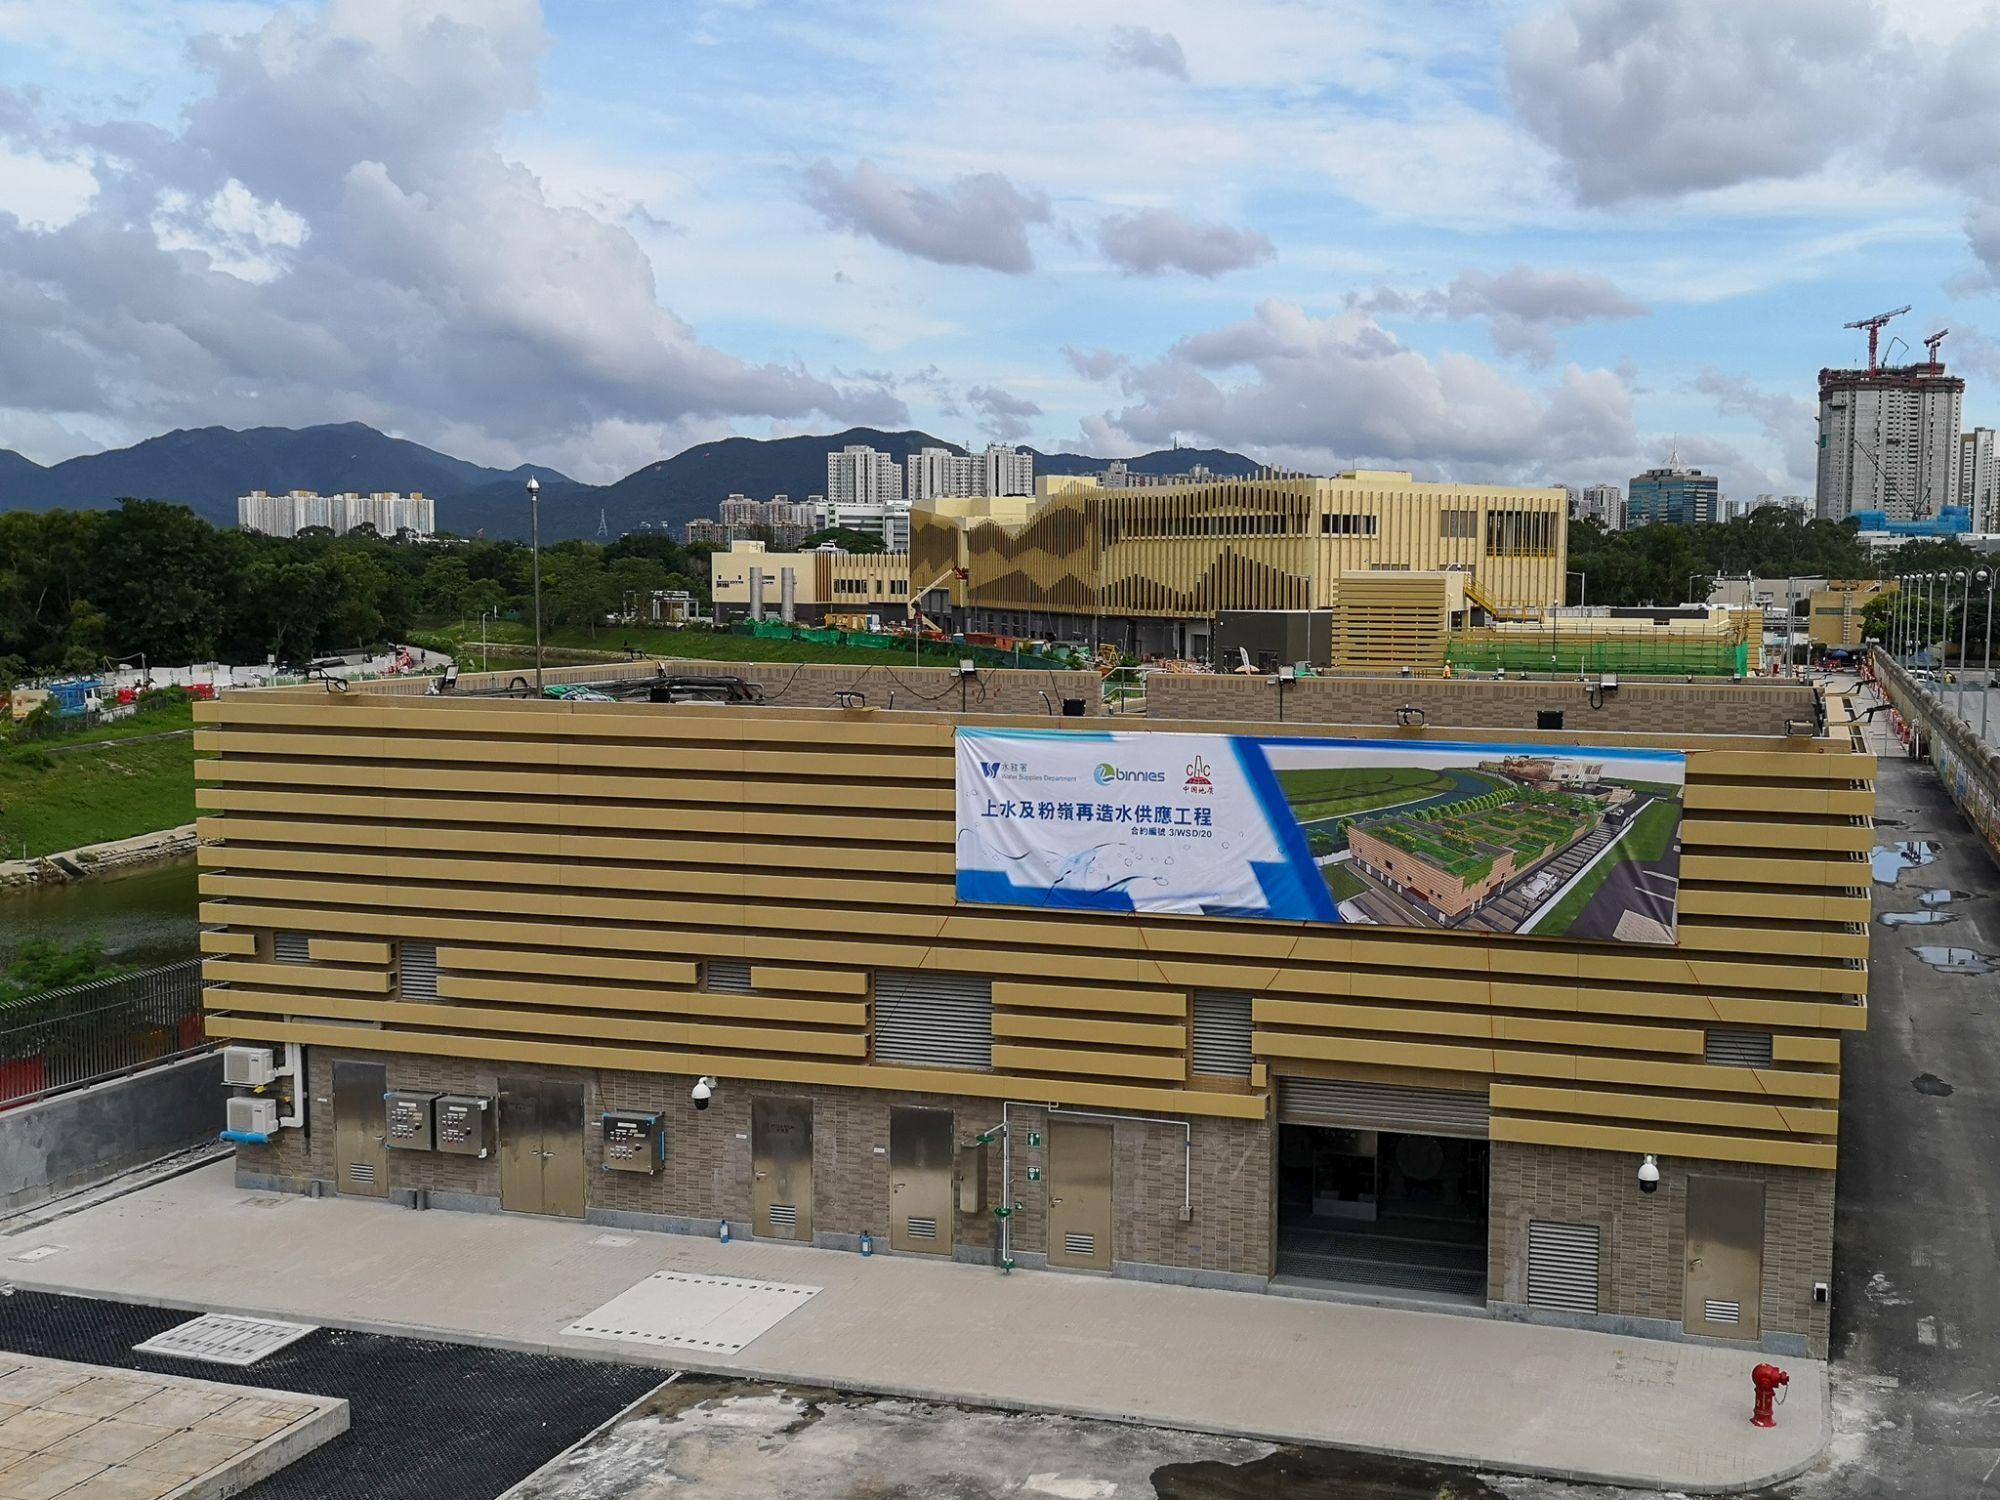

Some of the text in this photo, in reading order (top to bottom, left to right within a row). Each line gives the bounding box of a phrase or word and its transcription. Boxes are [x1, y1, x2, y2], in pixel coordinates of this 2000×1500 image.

[1019, 774, 1043, 783] Supplies
[1044, 775, 1077, 783] Department
[1116, 767, 1166, 783] binnies
[981, 799, 1213, 827] 上水及粉嶺再造水供應工程
[1131, 826, 1213, 839] 合約編號 3/WSD/20
